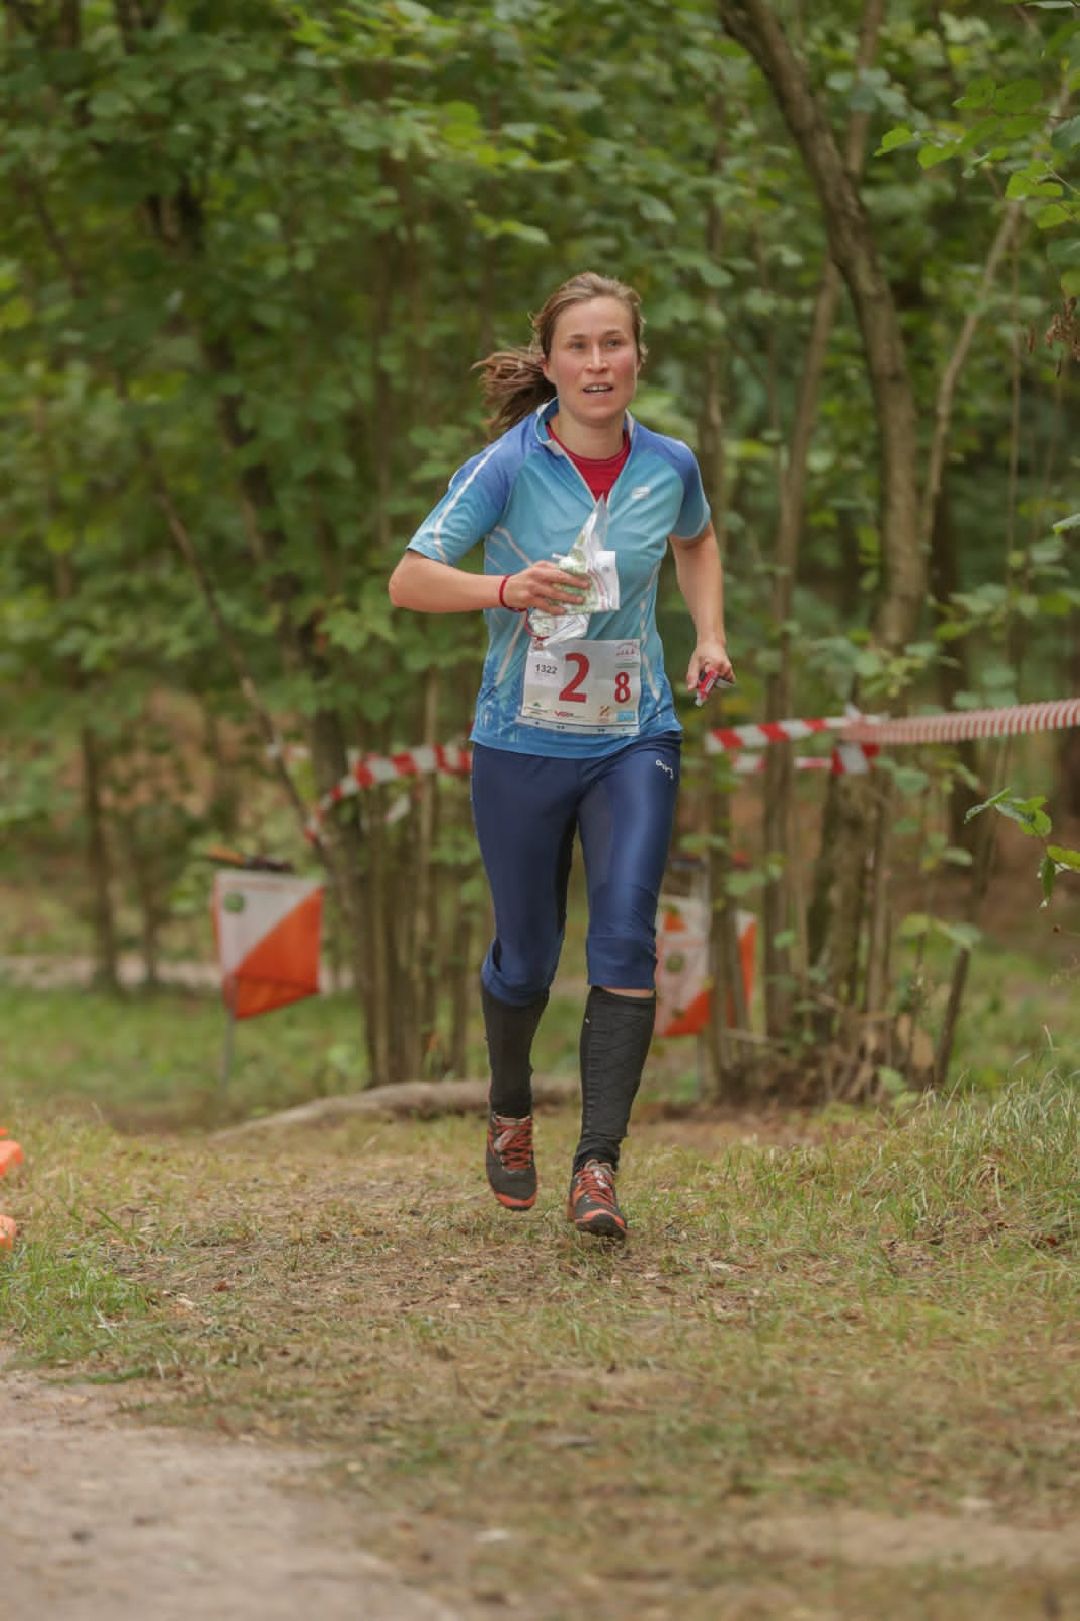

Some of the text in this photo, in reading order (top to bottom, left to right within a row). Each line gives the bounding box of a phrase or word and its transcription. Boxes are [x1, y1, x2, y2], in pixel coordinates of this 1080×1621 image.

[535, 664, 558, 675] 1322
[558, 652, 590, 703] 2
[614, 671, 631, 704] 8
